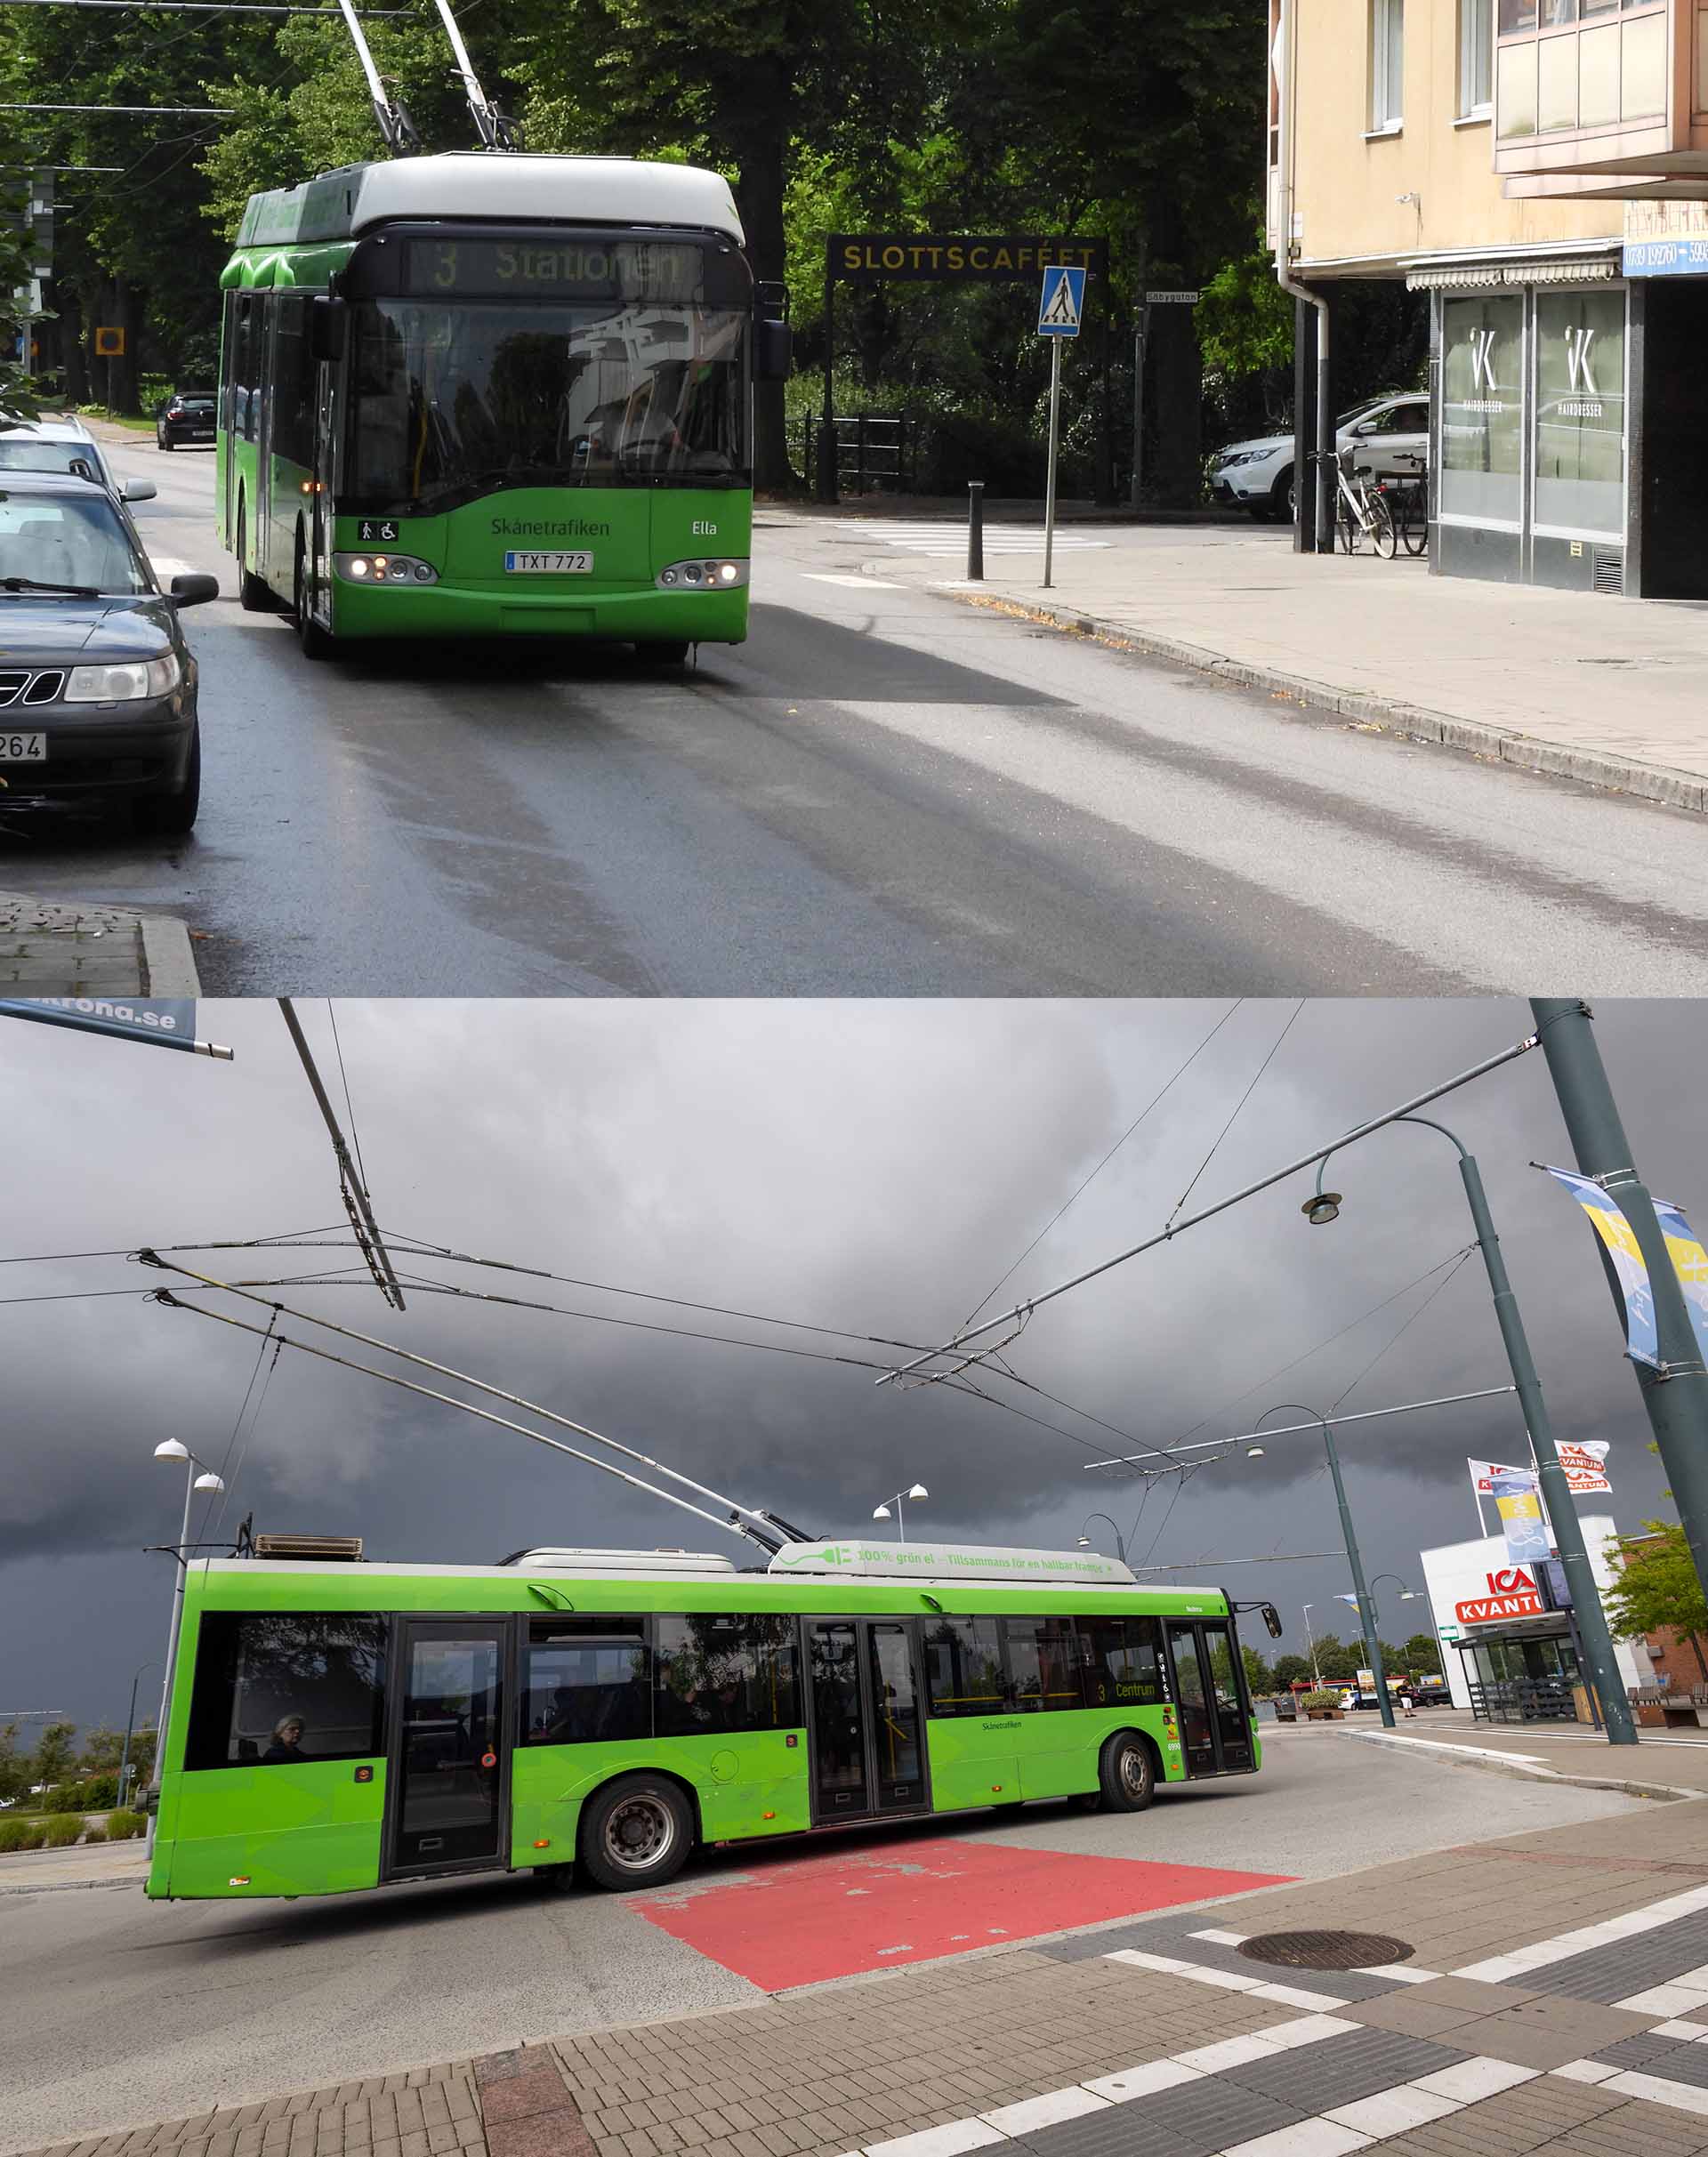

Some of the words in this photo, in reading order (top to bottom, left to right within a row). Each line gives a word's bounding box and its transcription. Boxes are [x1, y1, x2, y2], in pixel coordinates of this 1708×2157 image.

[433, 244, 456, 287] 3
[1558, 402, 1602, 417] HAIRDRESSER
[491, 519, 610, 536] Skånetrafiken
[692, 521, 717, 535] Ella
[520, 555, 550, 569] TXT
[555, 555, 585, 570] 772
[28, 998, 177, 1029] krona.se
[858, 1550, 891, 1561] 100%
[896, 1553, 922, 1565] grön
[1486, 1567, 1536, 1595] ICA
[1461, 1595, 1542, 1622] KVANT
[1098, 1685, 1106, 1701] 3
[1116, 1683, 1156, 1698] Centrum
